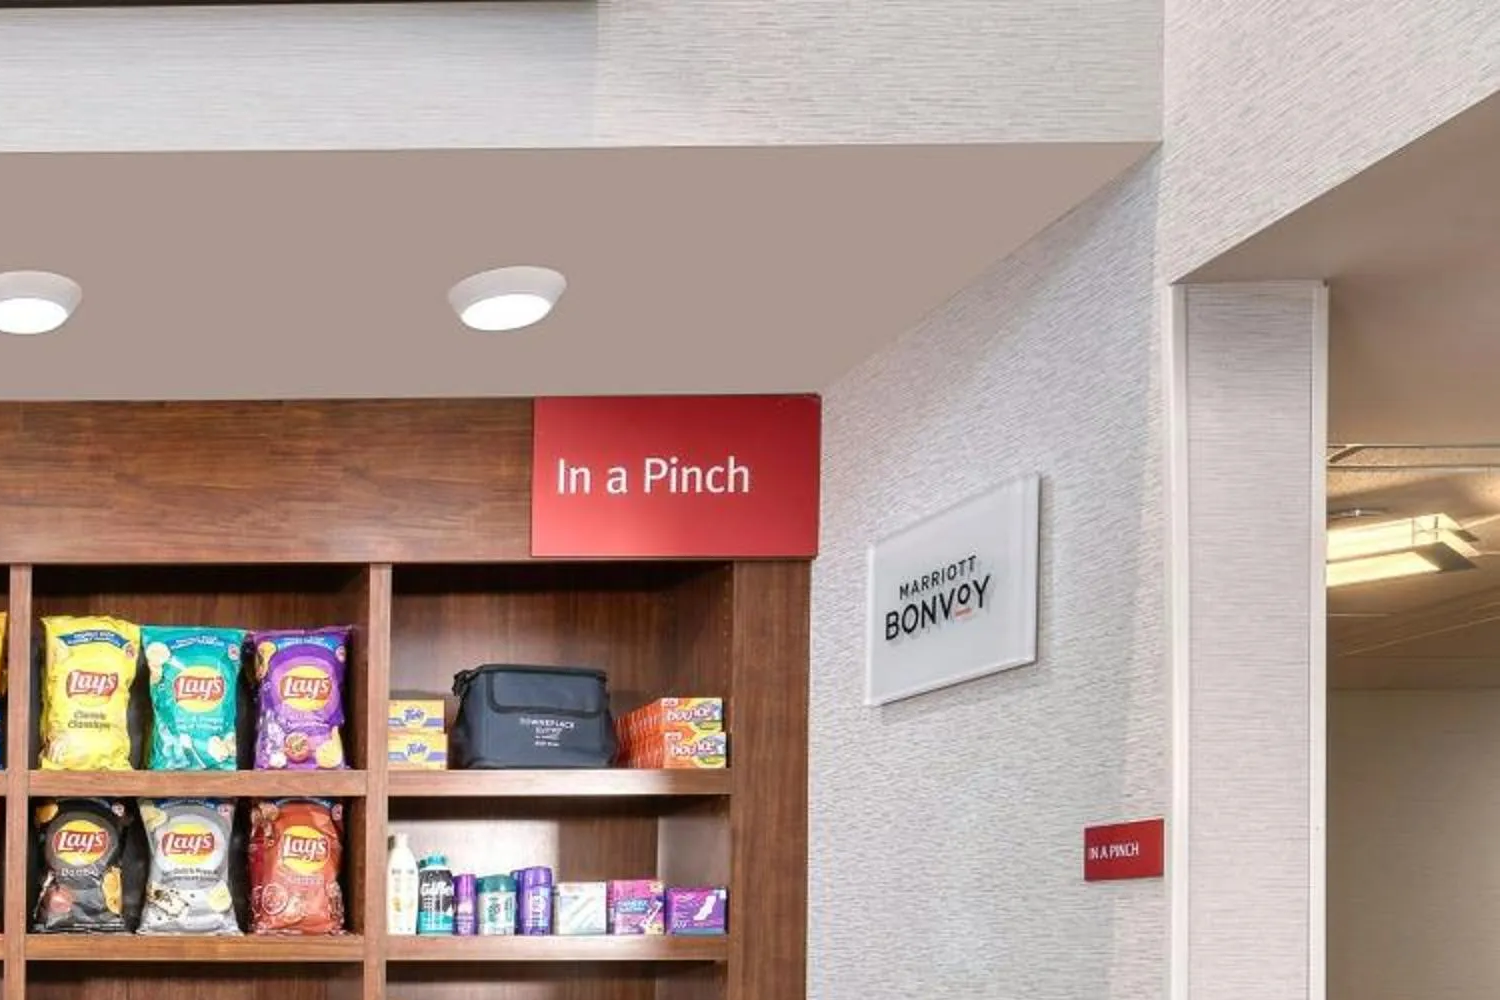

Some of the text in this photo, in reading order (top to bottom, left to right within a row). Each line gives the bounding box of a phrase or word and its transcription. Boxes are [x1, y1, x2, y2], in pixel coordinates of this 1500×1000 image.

[557, 455, 750, 494] In a Pinch
[899, 554, 977, 601] MARRIOTT
[885, 573, 992, 641] BONVOY
[57, 830, 109, 855] Lay's
[1109, 841, 1140, 860] PINCH
